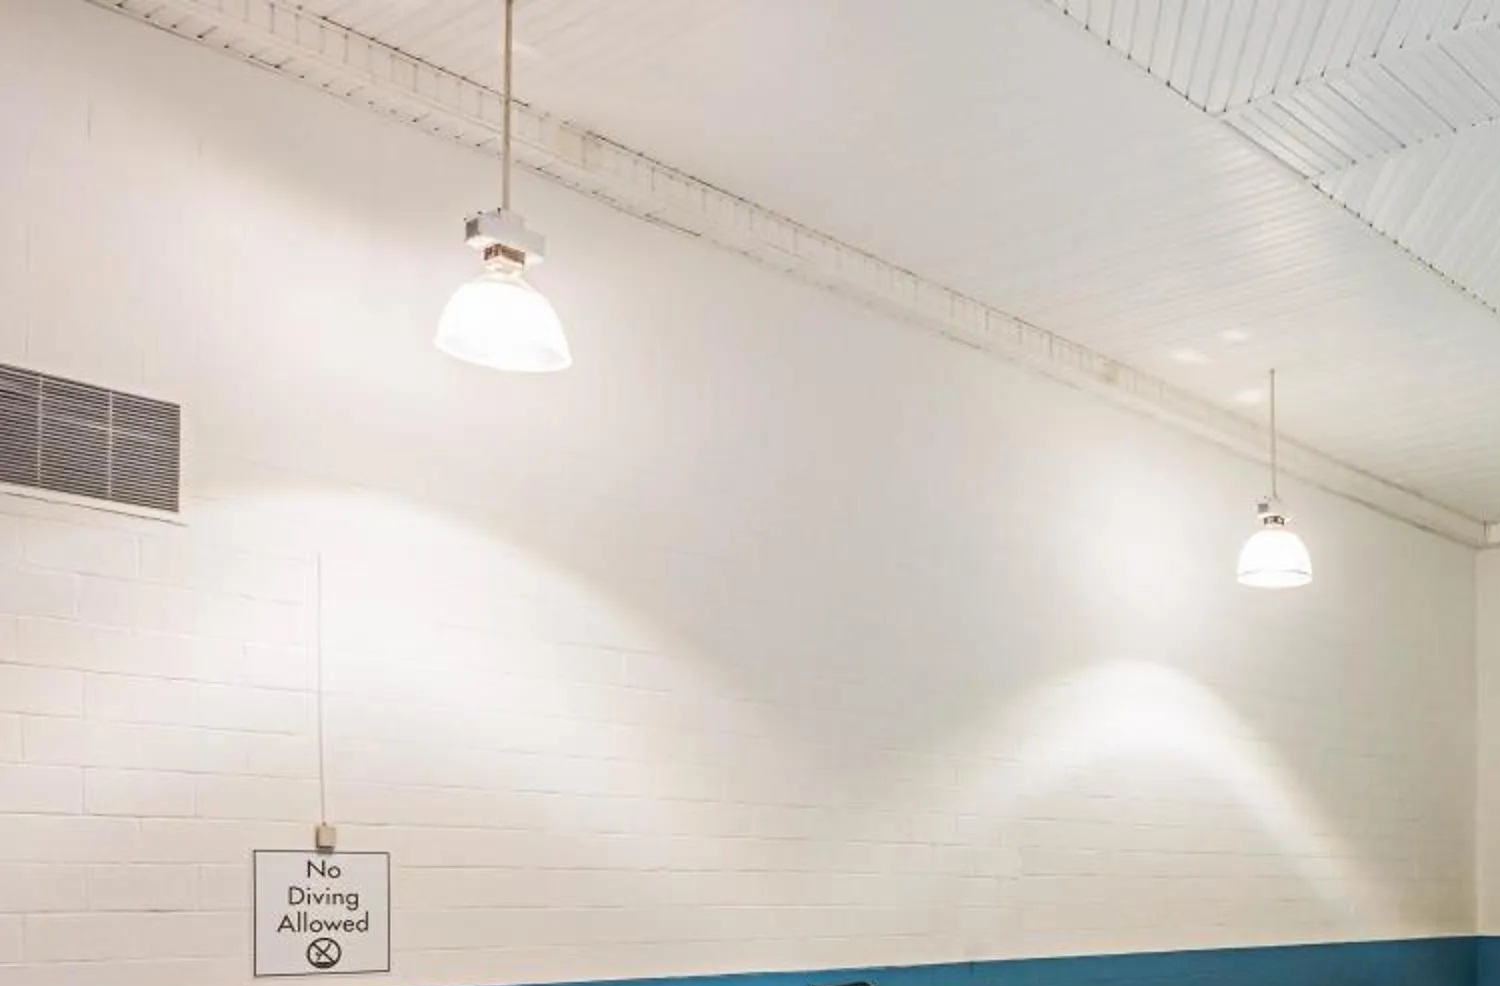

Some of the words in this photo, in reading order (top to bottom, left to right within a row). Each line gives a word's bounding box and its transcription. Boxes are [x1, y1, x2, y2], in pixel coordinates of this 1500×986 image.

[307, 860, 341, 878] No
[288, 886, 359, 911] Diving
[277, 911, 369, 933] Allowed
